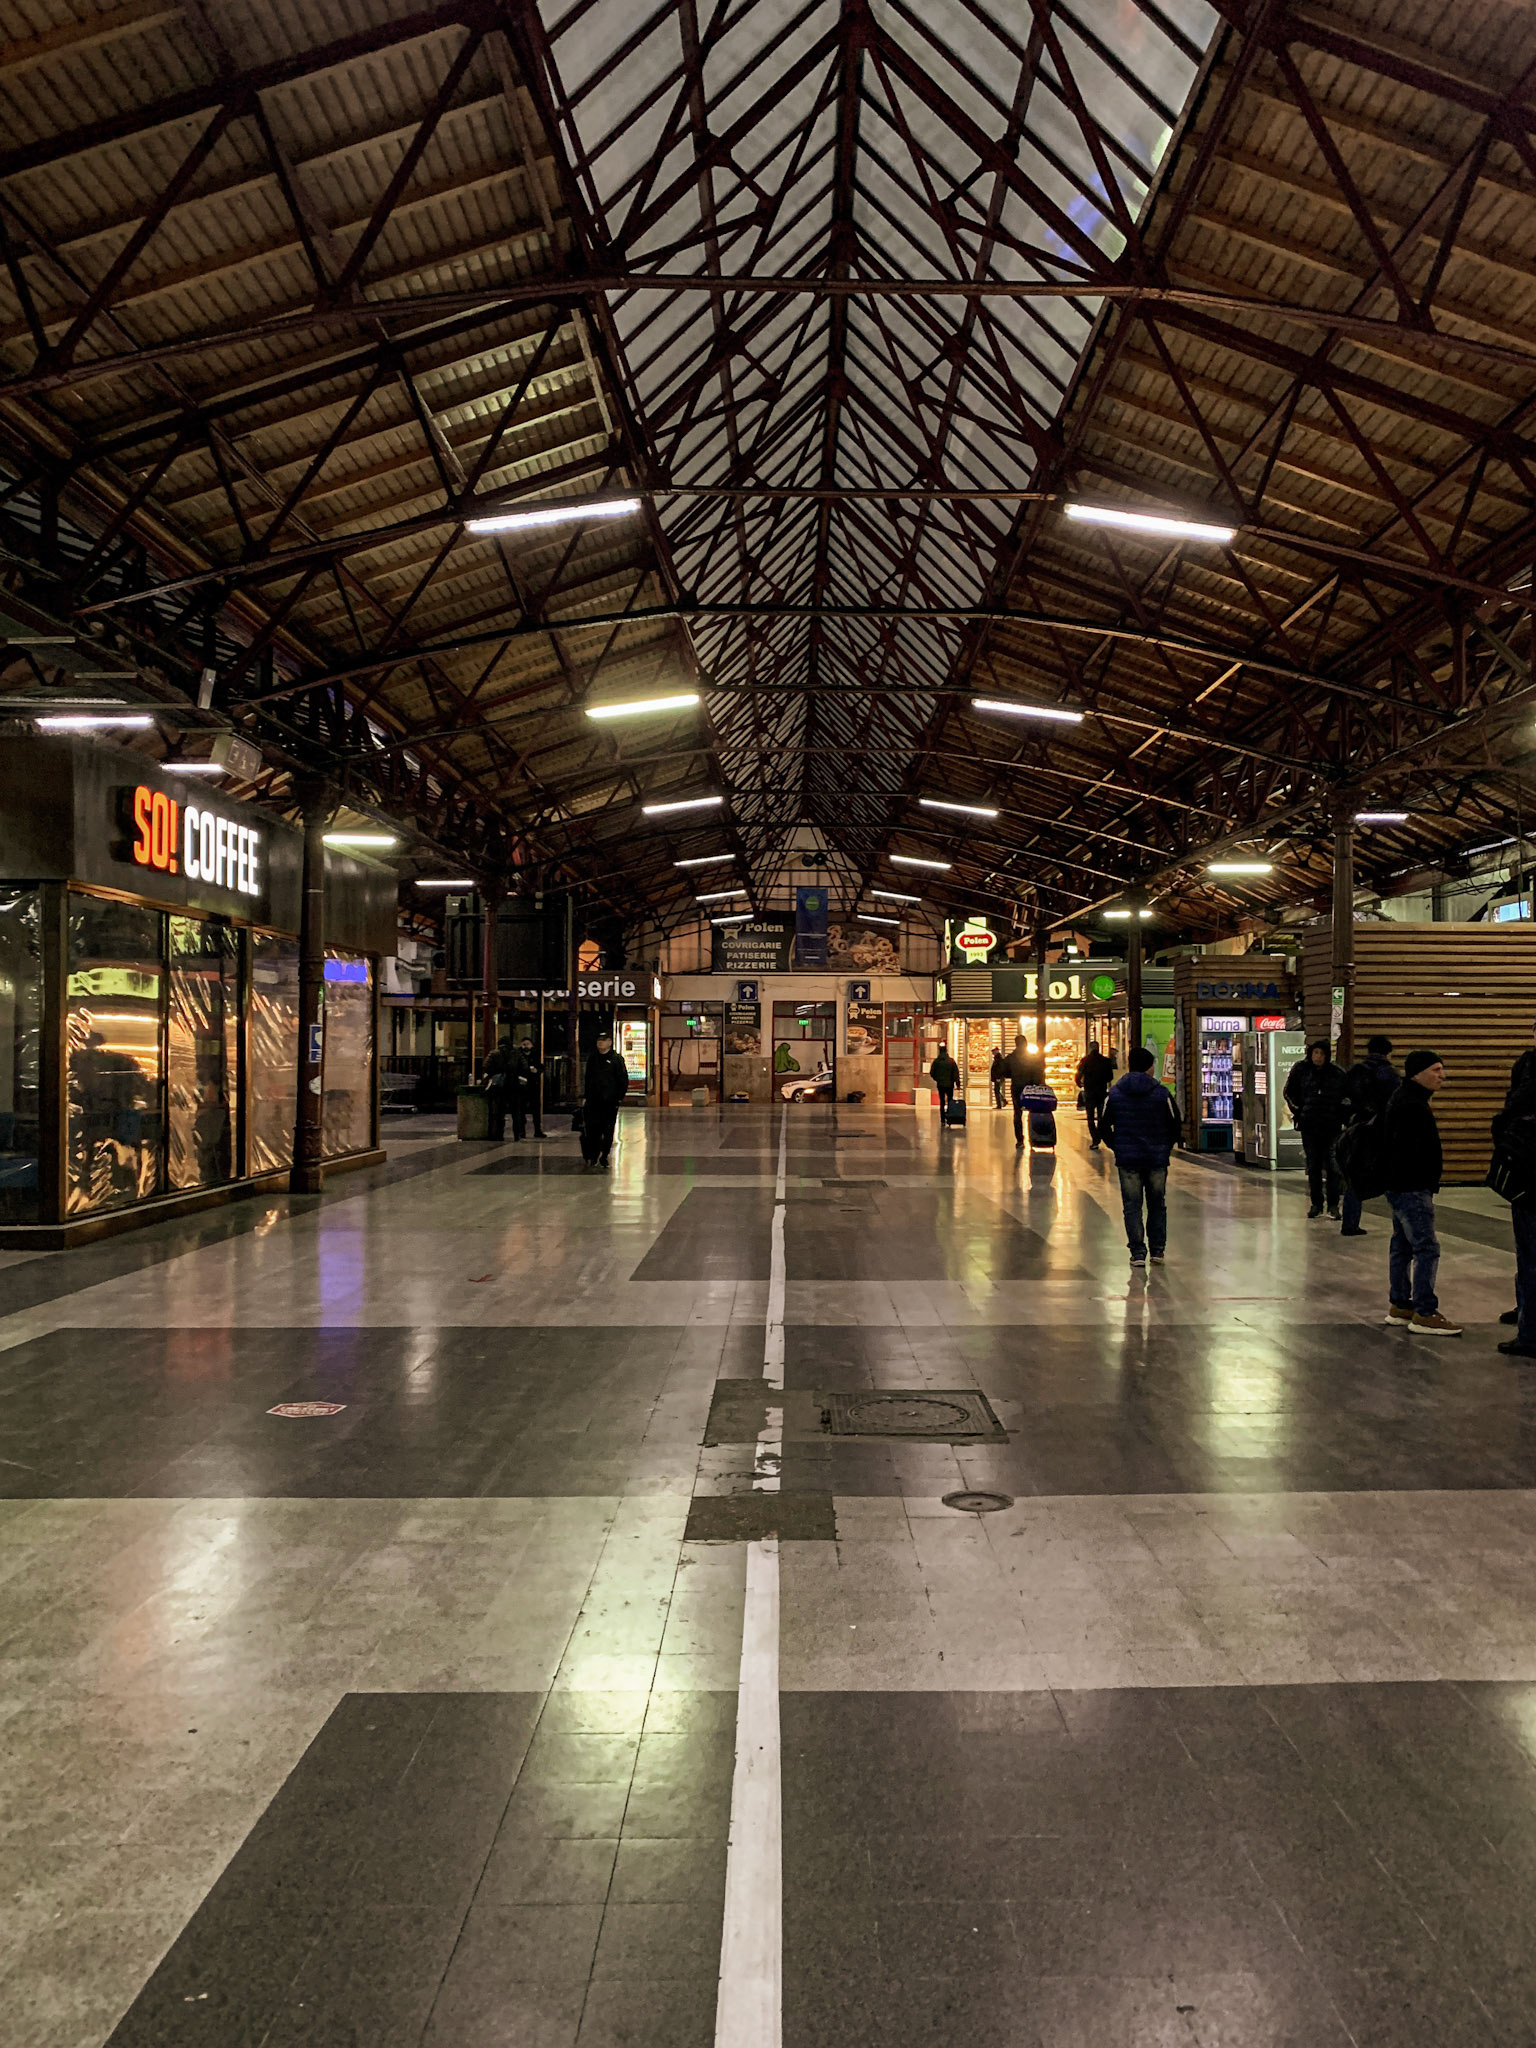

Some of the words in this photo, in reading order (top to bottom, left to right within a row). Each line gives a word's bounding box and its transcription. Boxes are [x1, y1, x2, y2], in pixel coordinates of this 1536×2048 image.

[133, 784, 178, 874] SO!
[183, 805, 259, 896] COFFEE
[745, 922, 785, 933] Polen
[963, 936, 989, 945] Polen
[721, 942, 782, 950] COVRIGARIE
[726, 952, 777, 960] PATISERIE
[726, 962, 777, 970] PIZZERIE
[860, 1007, 883, 1015] Polen
[1206, 1018, 1240, 1032] Dorna
